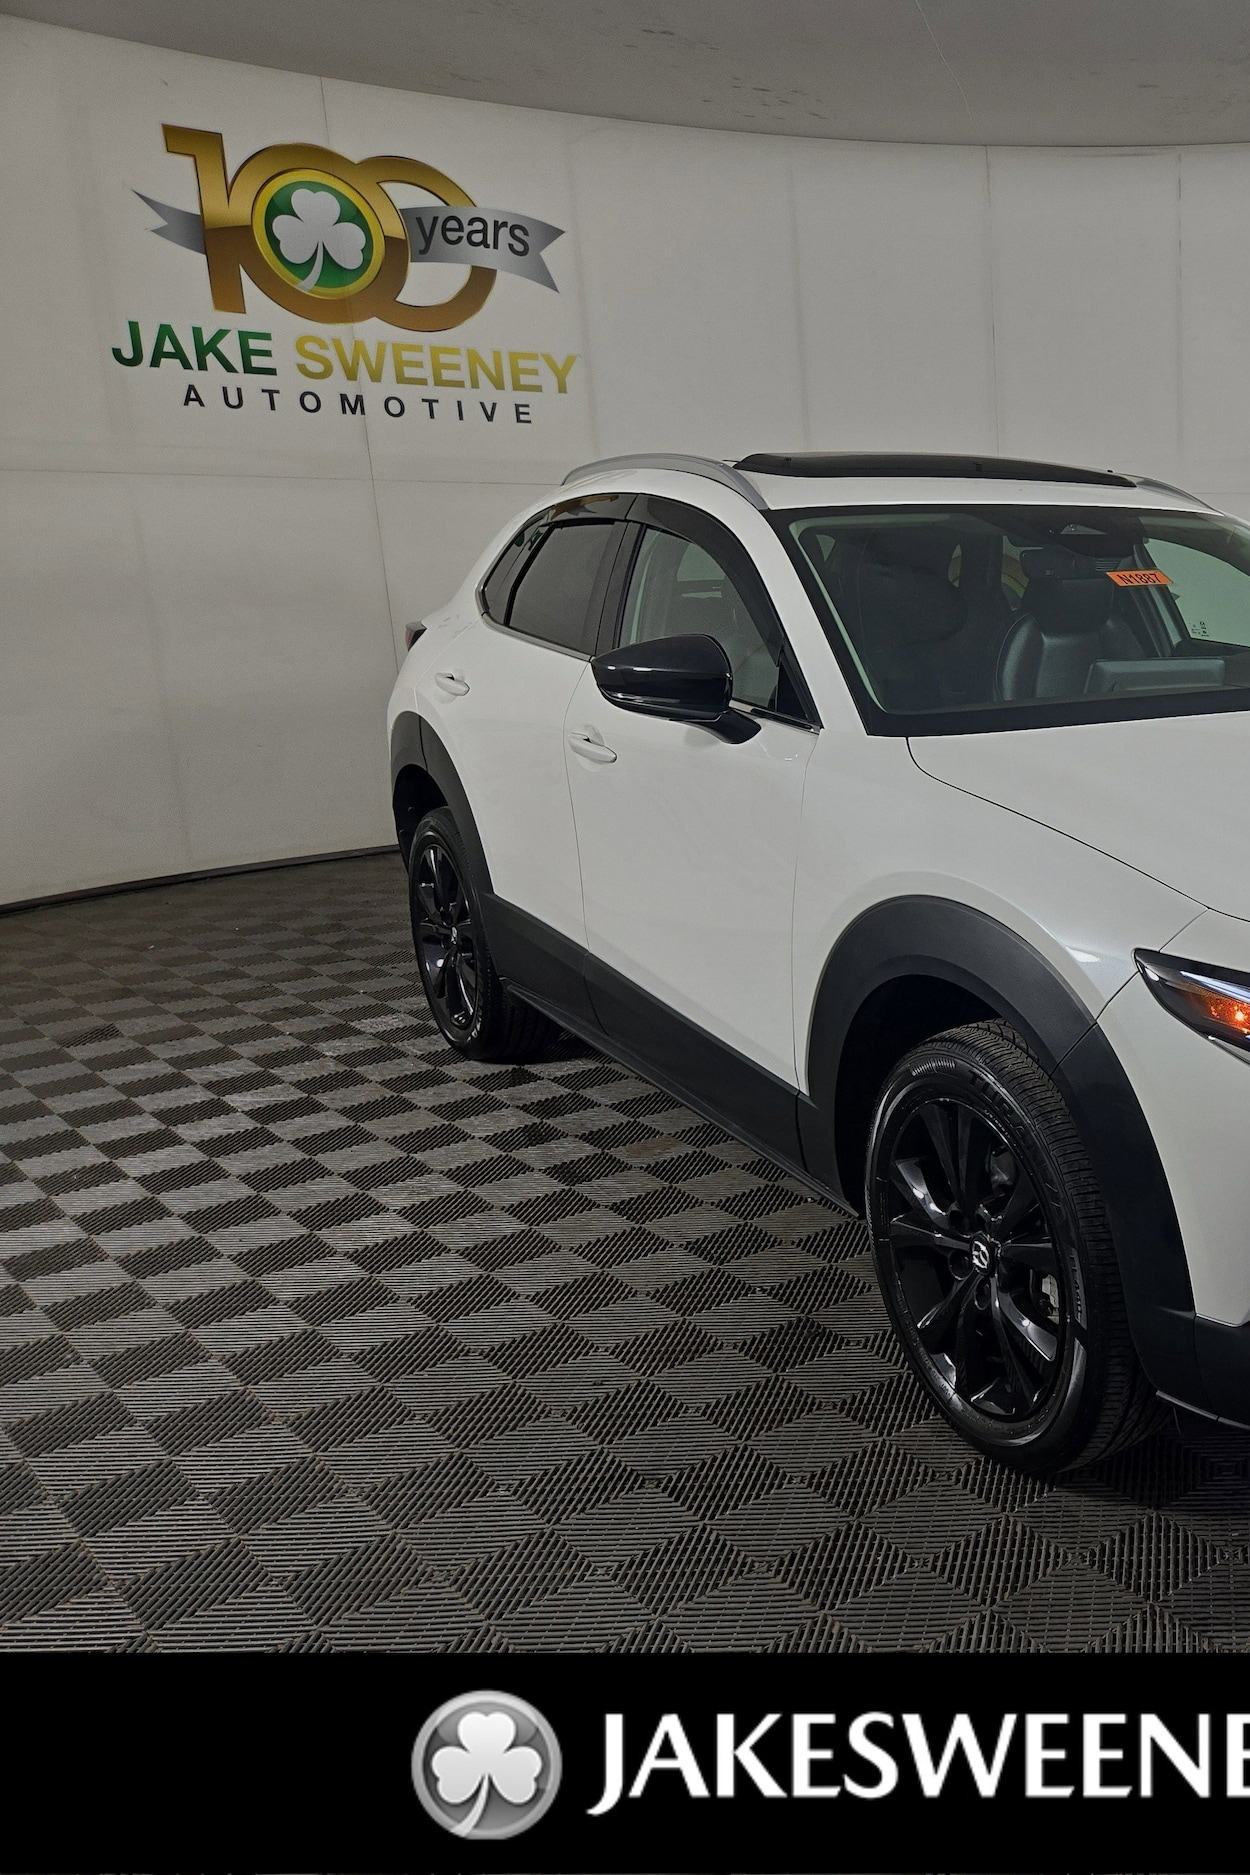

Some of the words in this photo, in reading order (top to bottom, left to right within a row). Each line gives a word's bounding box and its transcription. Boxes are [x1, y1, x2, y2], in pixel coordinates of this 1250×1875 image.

[161, 123, 497, 332] 100
[416, 213, 531, 257] years
[112, 320, 278, 377] JAKE
[295, 335, 578, 394] SWEENEY
[183, 384, 533, 425] AUTOMOTIVE
[1116, 573, 1162, 585] N1887
